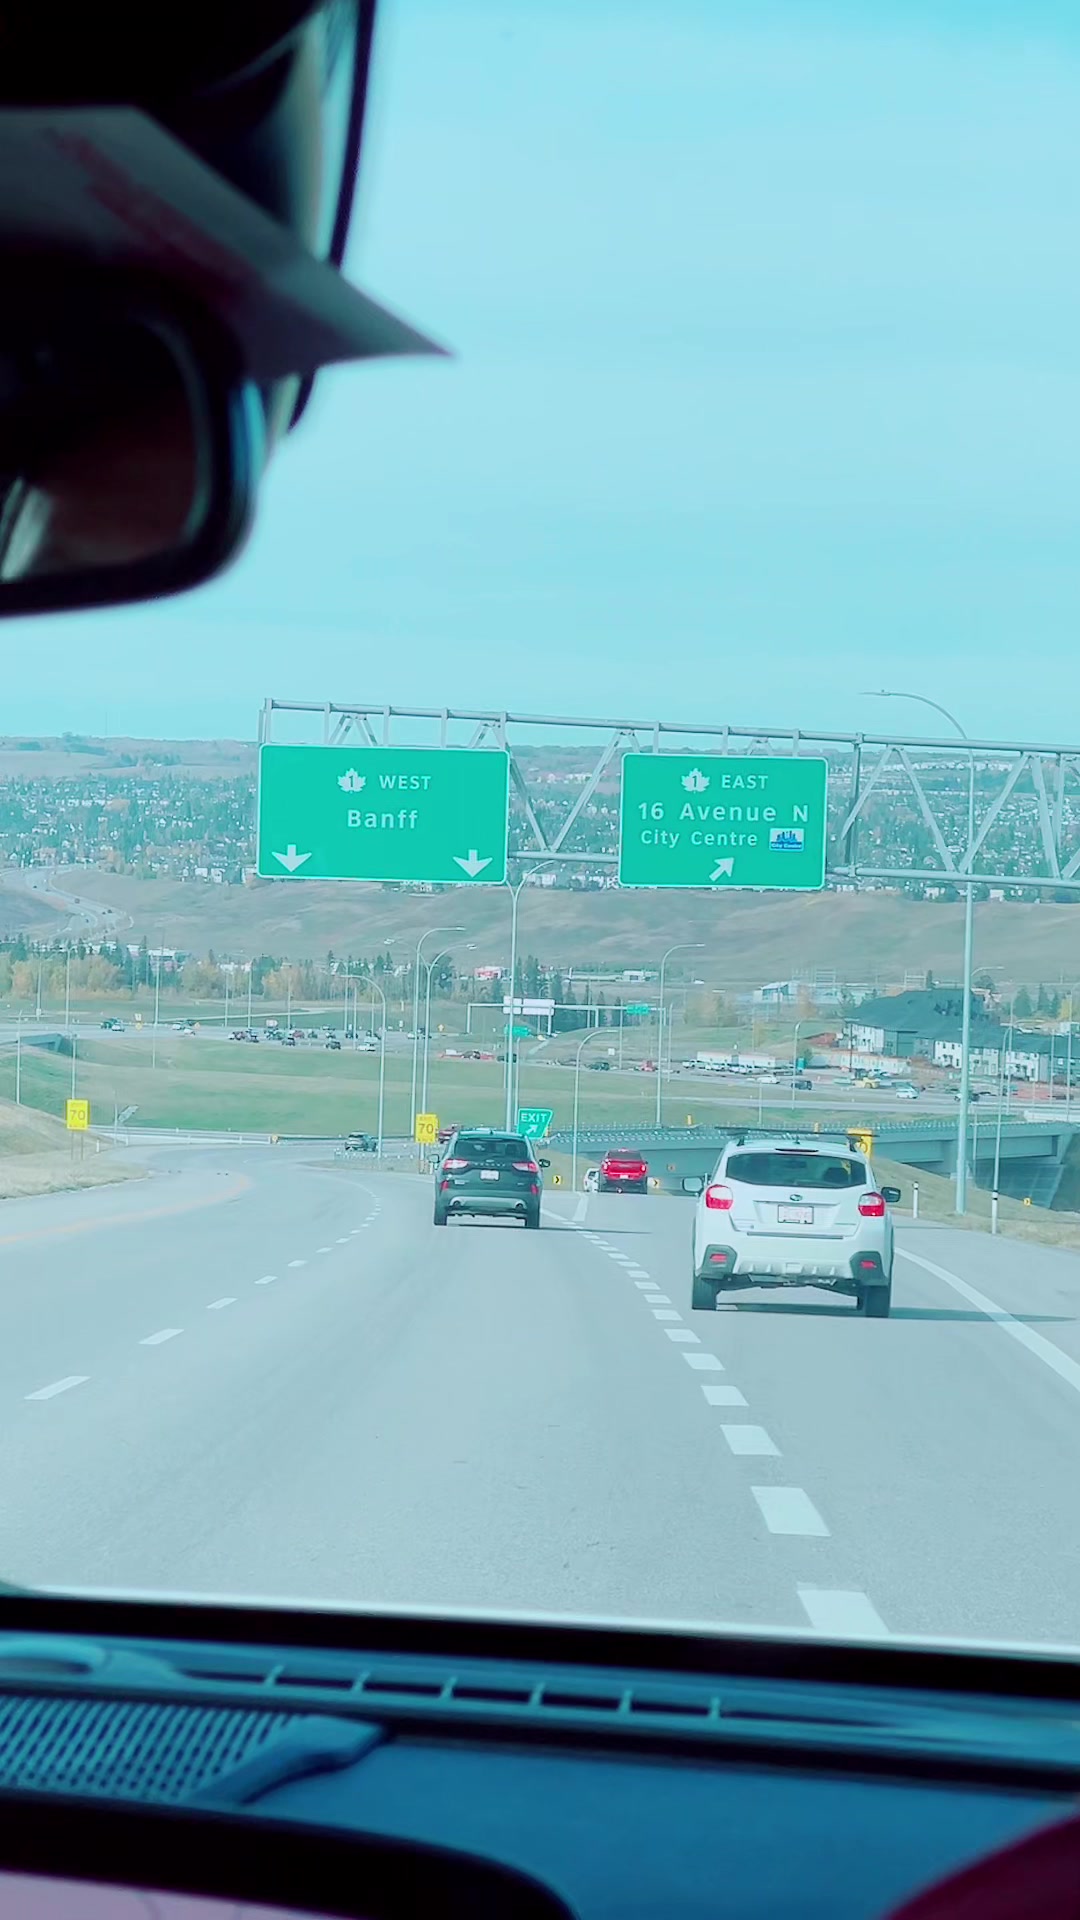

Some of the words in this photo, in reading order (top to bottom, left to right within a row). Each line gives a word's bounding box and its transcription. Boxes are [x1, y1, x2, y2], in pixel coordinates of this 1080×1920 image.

[379, 775, 431, 790] WEST
[721, 775, 769, 790] EAST
[347, 809, 418, 829] Banff
[638, 802, 665, 821] 16
[679, 803, 777, 822] Avenue
[792, 804, 809, 822] N
[641, 829, 680, 848] City
[690, 831, 758, 846] Centre
[69, 1109, 86, 1121] 70
[521, 1112, 548, 1123] EXIT
[418, 1123, 434, 1135] 70
